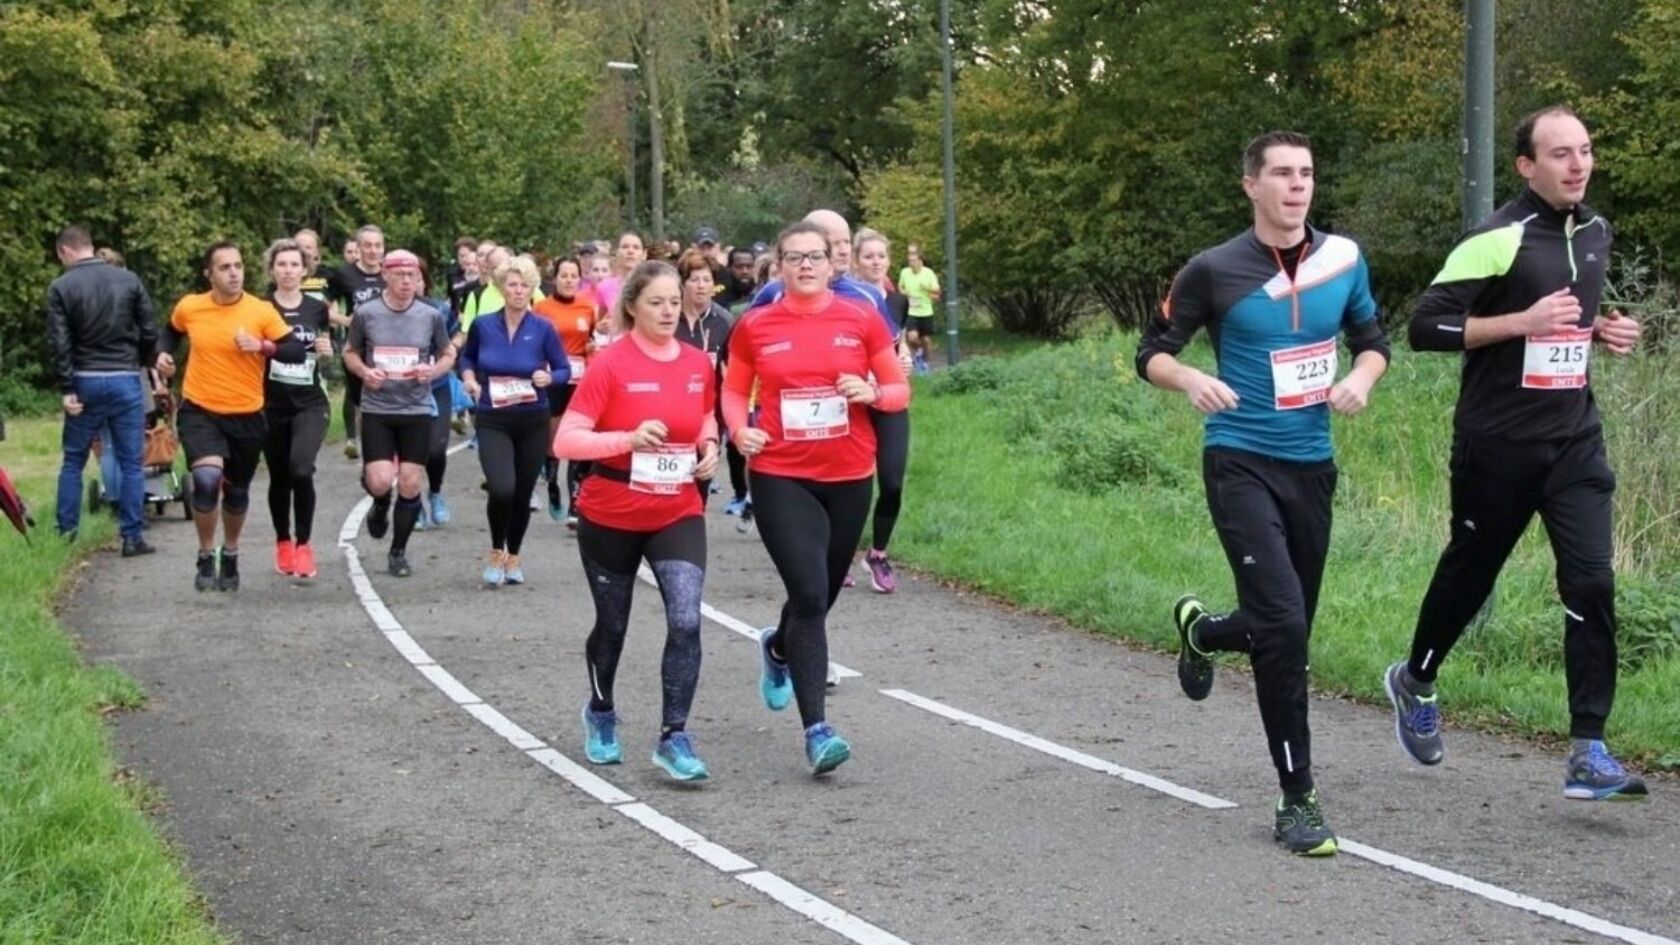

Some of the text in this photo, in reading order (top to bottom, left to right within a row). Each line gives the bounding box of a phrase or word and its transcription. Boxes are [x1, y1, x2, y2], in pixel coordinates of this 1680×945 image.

[1549, 346, 1583, 363] 215
[1296, 359, 1328, 381] 223
[810, 402, 820, 417] 7
[657, 456, 678, 472] 86
